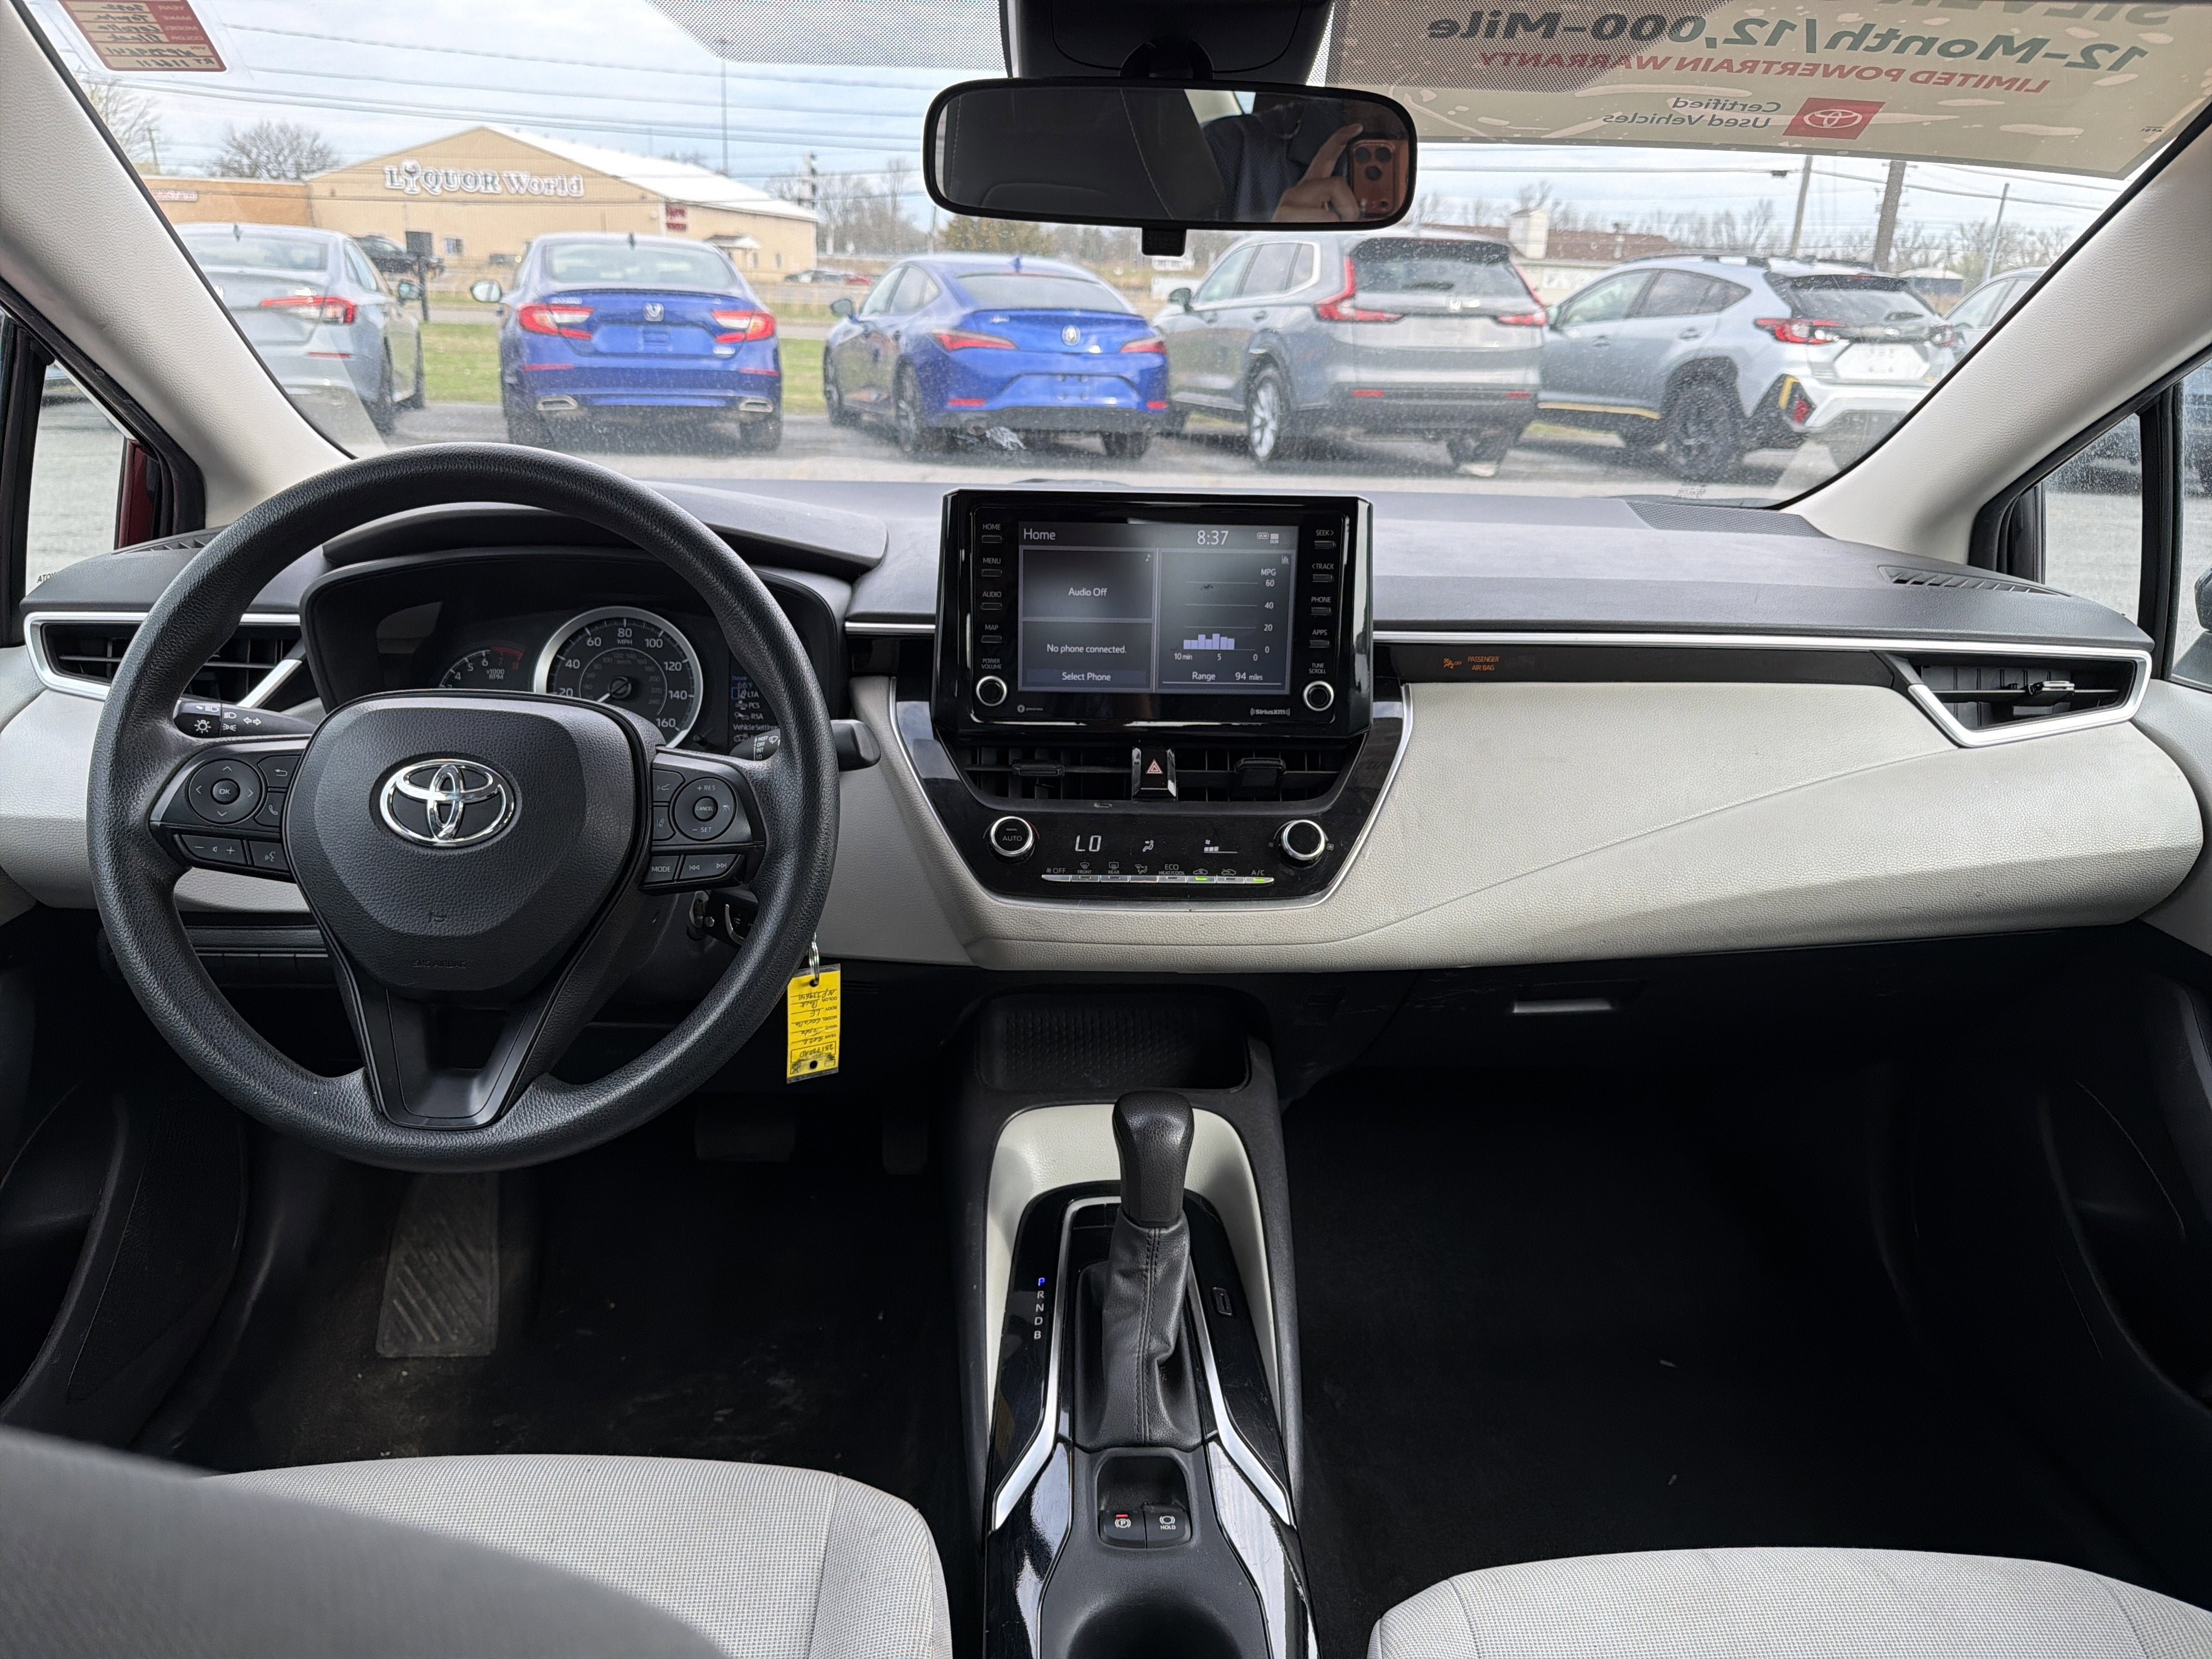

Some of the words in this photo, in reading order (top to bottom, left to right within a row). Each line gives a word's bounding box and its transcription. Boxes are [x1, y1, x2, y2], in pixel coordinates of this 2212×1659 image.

[503, 171, 584, 197] World
[1023, 528, 1056, 540] Home
[1197, 530, 1229, 545] 8:37
[1068, 588, 1091, 596] Audio
[1093, 588, 1108, 597] Off
[617, 628, 632, 637] 80
[586, 637, 601, 647] 60
[645, 638, 663, 648] 100
[1047, 644, 1058, 653] No
[1060, 645, 1084, 656] phone
[1085, 645, 1127, 654] connected.
[467, 663, 474, 672] 5
[566, 659, 580, 669] 40
[663, 661, 681, 672] 120
[454, 672, 461, 680] 4
[1062, 672, 1085, 681] Select
[1087, 672, 1111, 681] Phone
[1192, 672, 1216, 682] Range
[1235, 672, 1246, 680] 94
[559, 688, 573, 697] 20
[668, 690, 687, 700] 140
[656, 718, 676, 728] 160
[1075, 835, 1102, 852] LO
[1038, 1277, 1045, 1286] P
[1037, 1290, 1045, 1299] R
[1036, 1304, 1044, 1312] N
[1035, 1317, 1042, 1325] D
[1034, 1330, 1041, 1339] B
